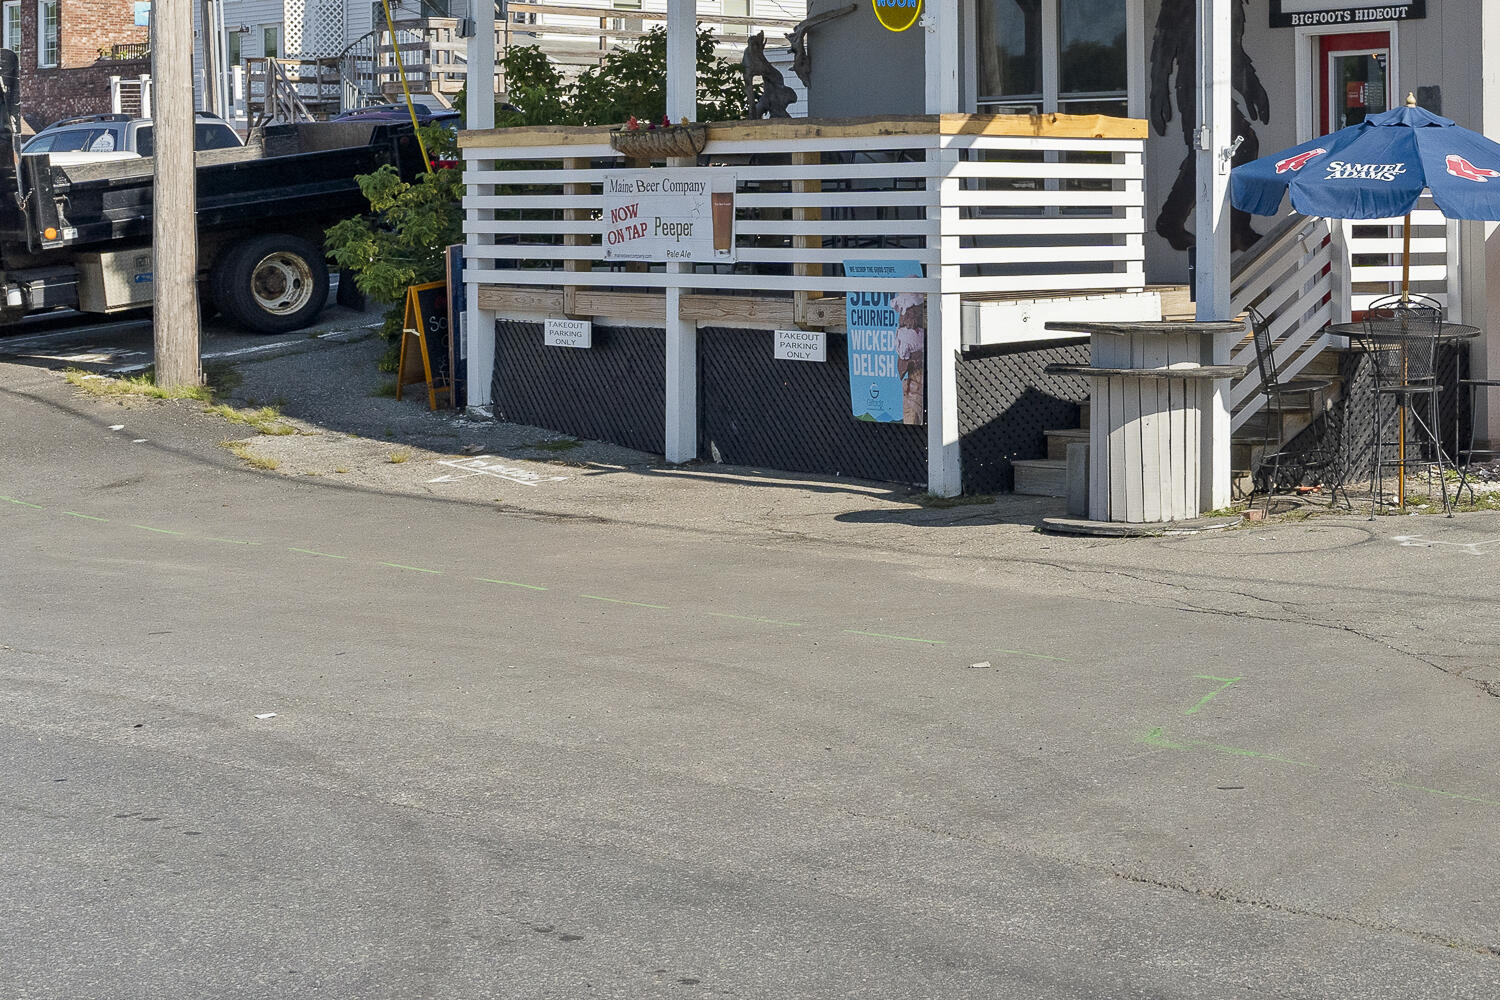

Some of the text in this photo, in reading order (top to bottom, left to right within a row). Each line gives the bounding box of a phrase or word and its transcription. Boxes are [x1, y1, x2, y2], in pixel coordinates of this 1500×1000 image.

[1291, 6, 1409, 25] BIGFOOTS HIDEOUT
[1325, 160, 1407, 174] SAMUEL
[1323, 169, 1396, 182] ADAMS
[609, 177, 706, 196] Maine Beer Company
[610, 203, 639, 224] NOW
[607, 222, 648, 246] ON TAP
[654, 216, 694, 242] Peeper
[666, 249, 692, 258] Pale Ale
[548, 321, 584, 329] TAKEOUT
[850, 309, 898, 327] CHURNED.
[555, 338, 577, 346] ONLY
[778, 332, 820, 341] TAKEOUT
[851, 329, 895, 352] WICKED
[780, 341, 818, 351] PARKING
[786, 350, 811, 359] ONLY
[852, 353, 898, 378] DELISH.
